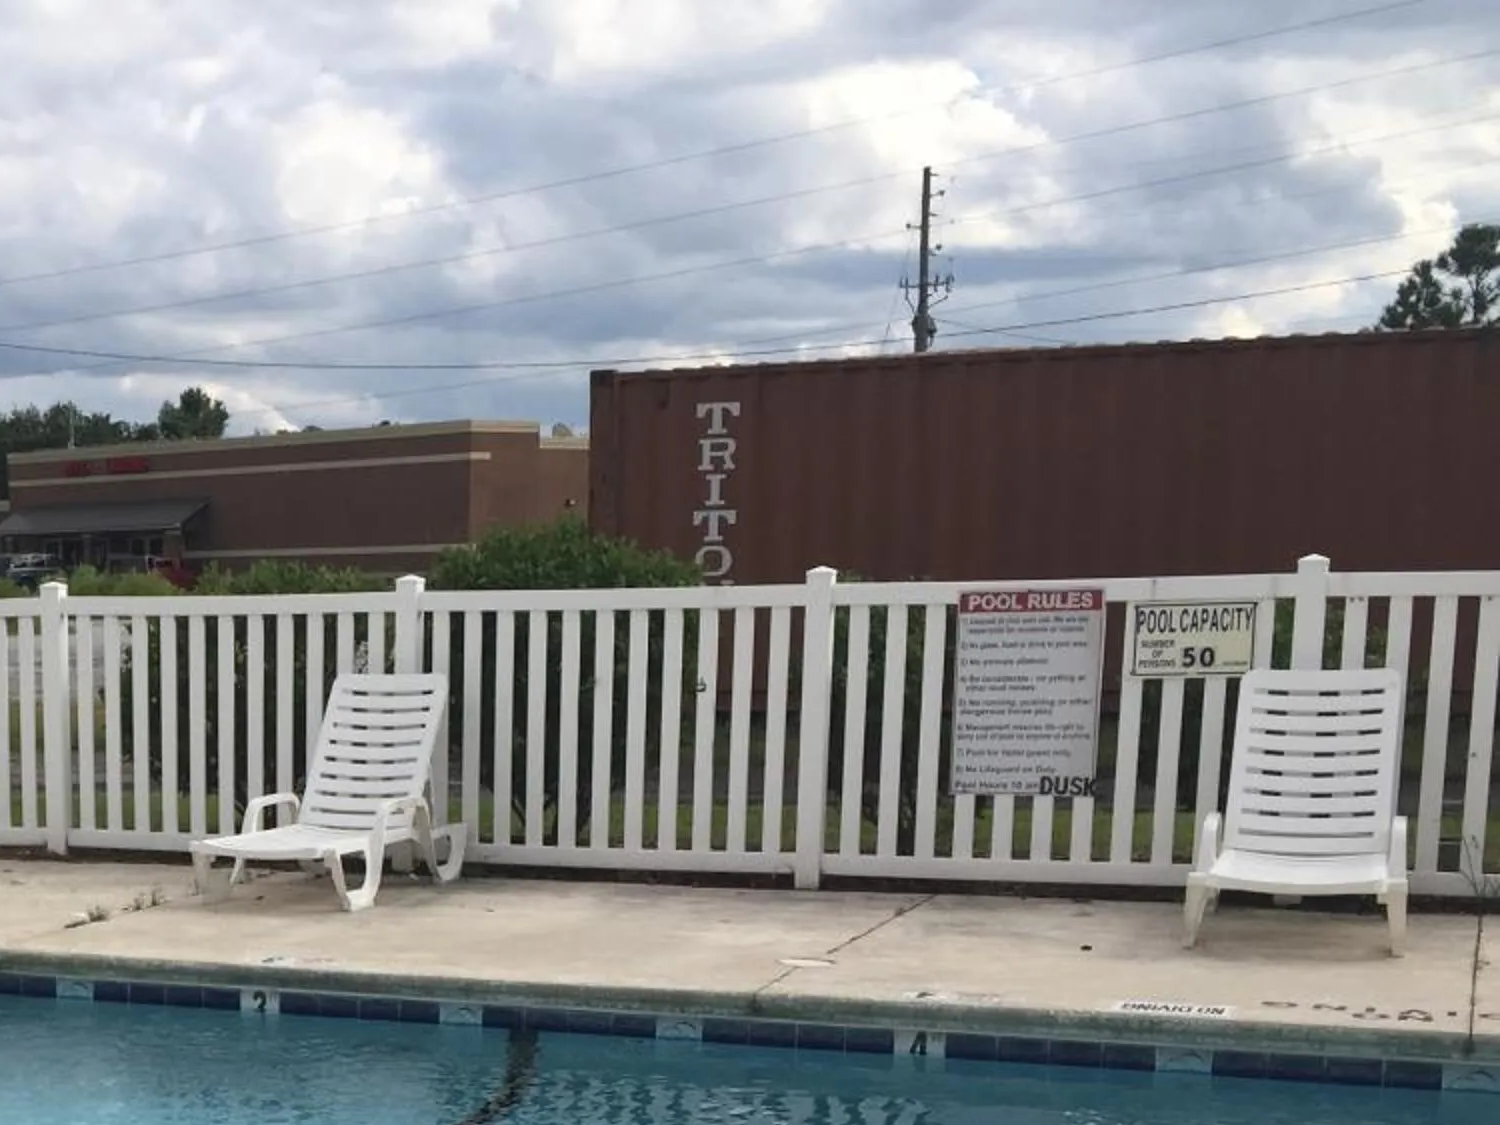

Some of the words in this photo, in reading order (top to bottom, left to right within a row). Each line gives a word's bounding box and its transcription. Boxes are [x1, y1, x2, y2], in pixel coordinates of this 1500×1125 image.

[693, 402, 741, 585] TRITO
[968, 594, 1023, 611] POOL
[1027, 592, 1093, 609] RULES
[1136, 608, 1177, 634] POOL
[1179, 607, 1253, 632] CAPACITY
[1182, 647, 1216, 668] 50
[1040, 775, 1097, 796] DUSK
